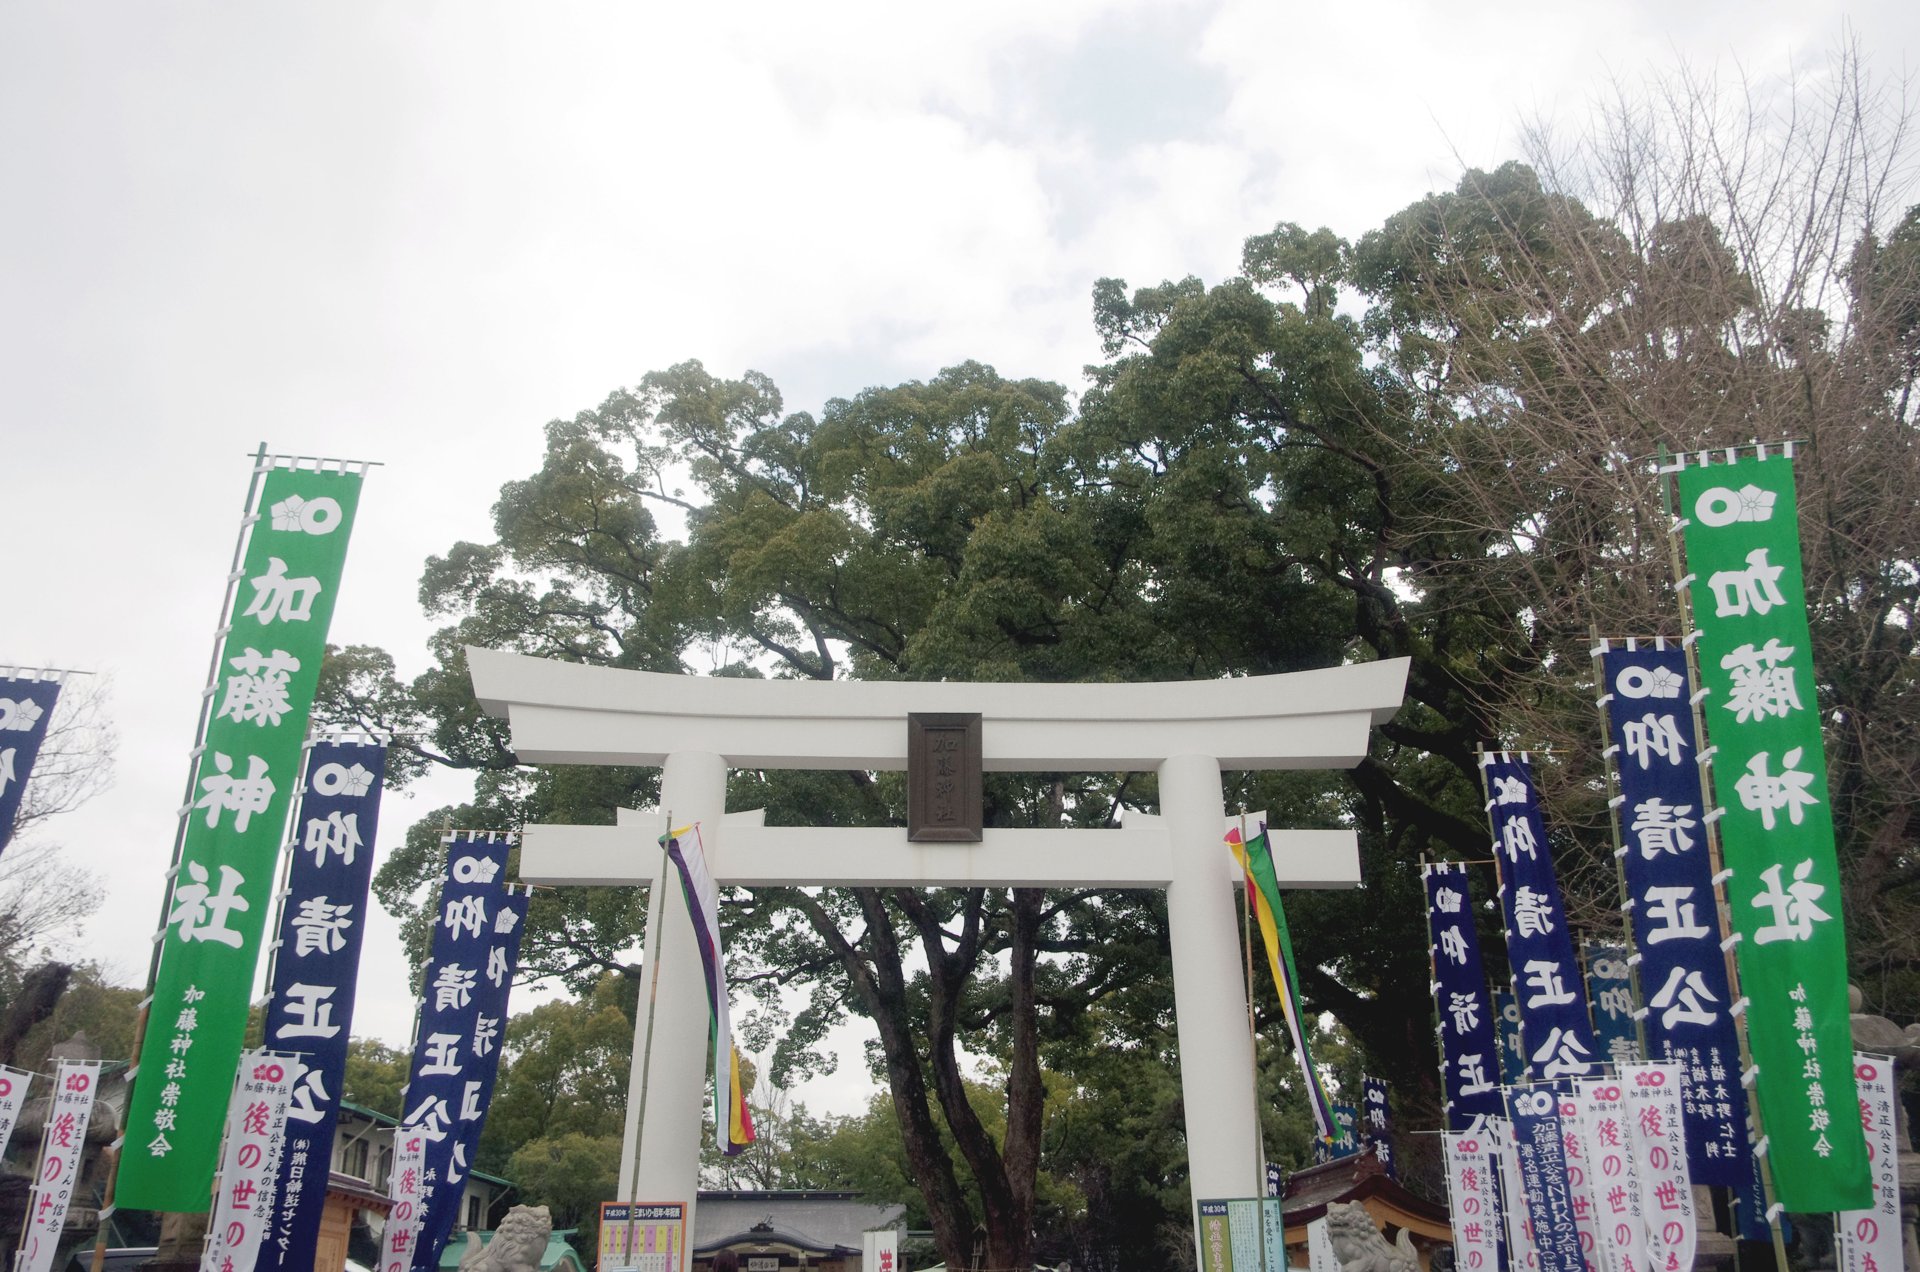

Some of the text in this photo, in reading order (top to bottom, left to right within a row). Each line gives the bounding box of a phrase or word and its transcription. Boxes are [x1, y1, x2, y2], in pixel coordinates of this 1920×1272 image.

[169, 556, 322, 949] 加藤神社
[147, 984, 205, 1157] 加藤神社崇敬会
[244, 1081, 287, 1095] 加藤神社
[1629, 1086, 1673, 1099] 加藤神社
[1855, 1081, 1886, 1094] 神社
[253, 1102, 287, 1218] 清正公さんの信念
[1453, 1153, 1485, 1162] 加藤神社
[1665, 1103, 1690, 1217] 清正公さんの信念
[1877, 1100, 1897, 1215] 清正公さんの信念
[1478, 1166, 1494, 1249] 清正公さんの信念
